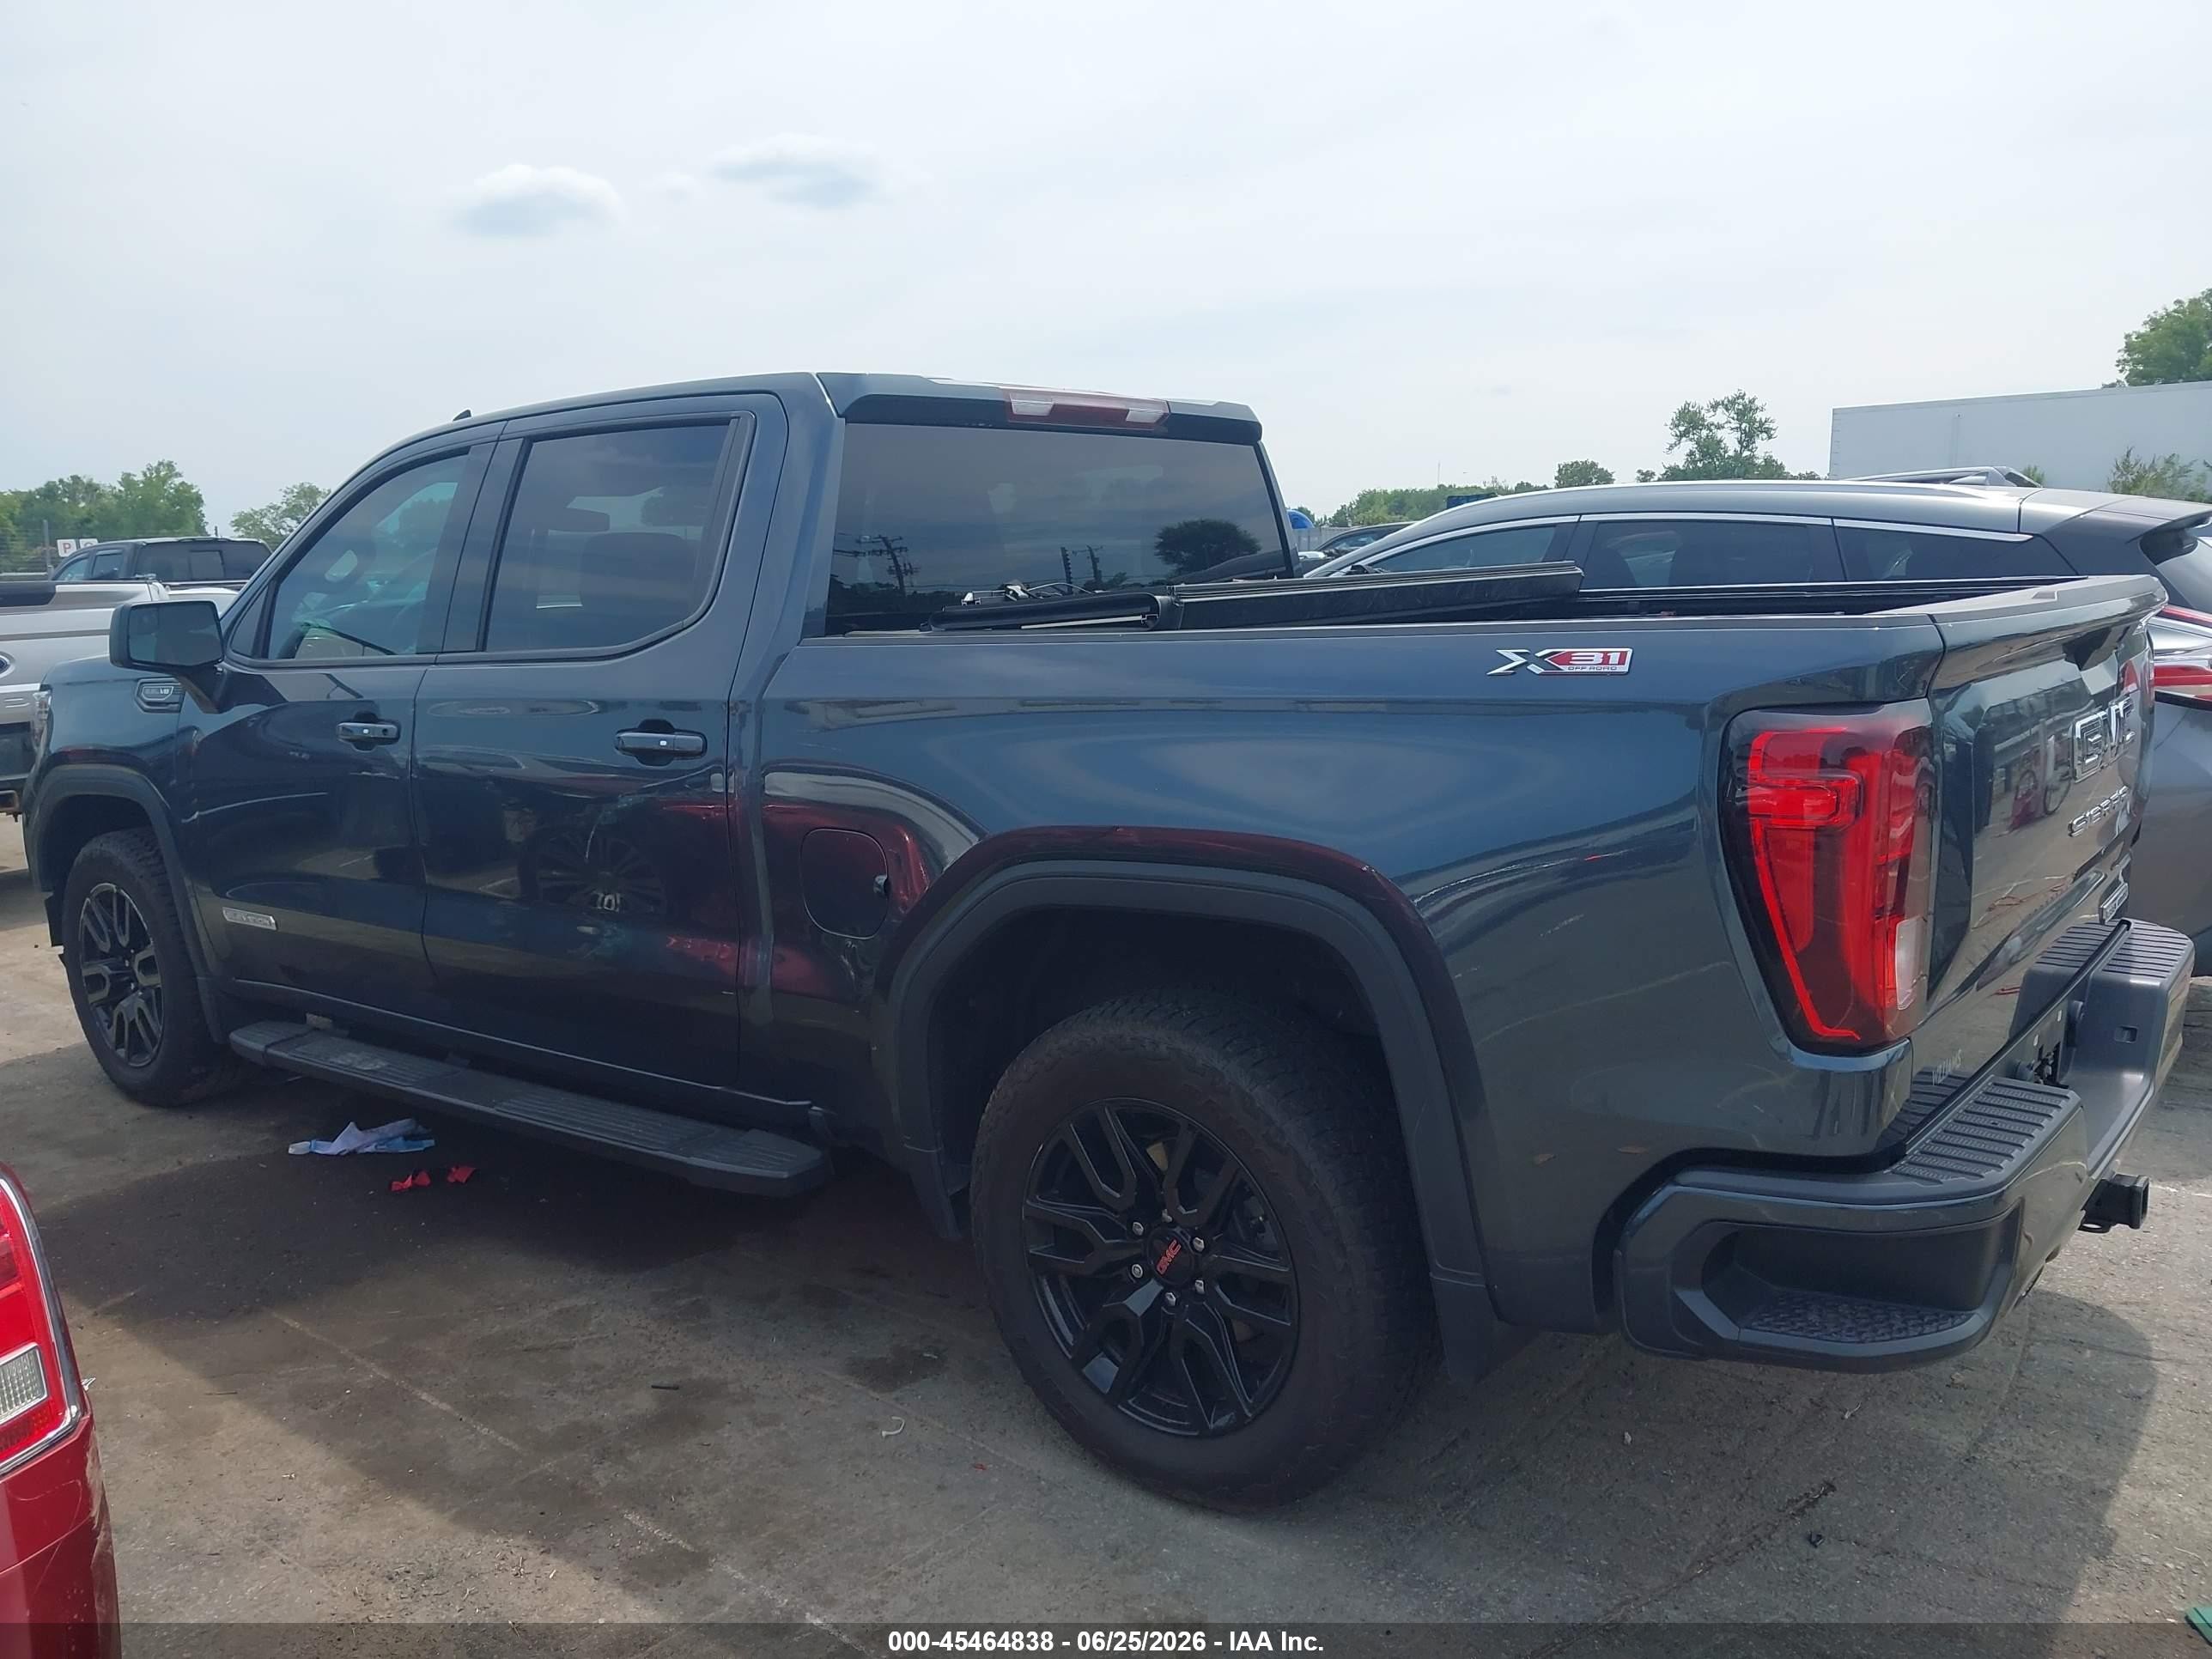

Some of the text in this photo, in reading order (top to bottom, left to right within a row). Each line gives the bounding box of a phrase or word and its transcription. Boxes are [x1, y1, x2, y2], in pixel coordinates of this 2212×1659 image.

[62, 542, 71, 554] P
[1486, 647, 1633, 676] X31
[1157, 1239, 1182, 1274] GMC
